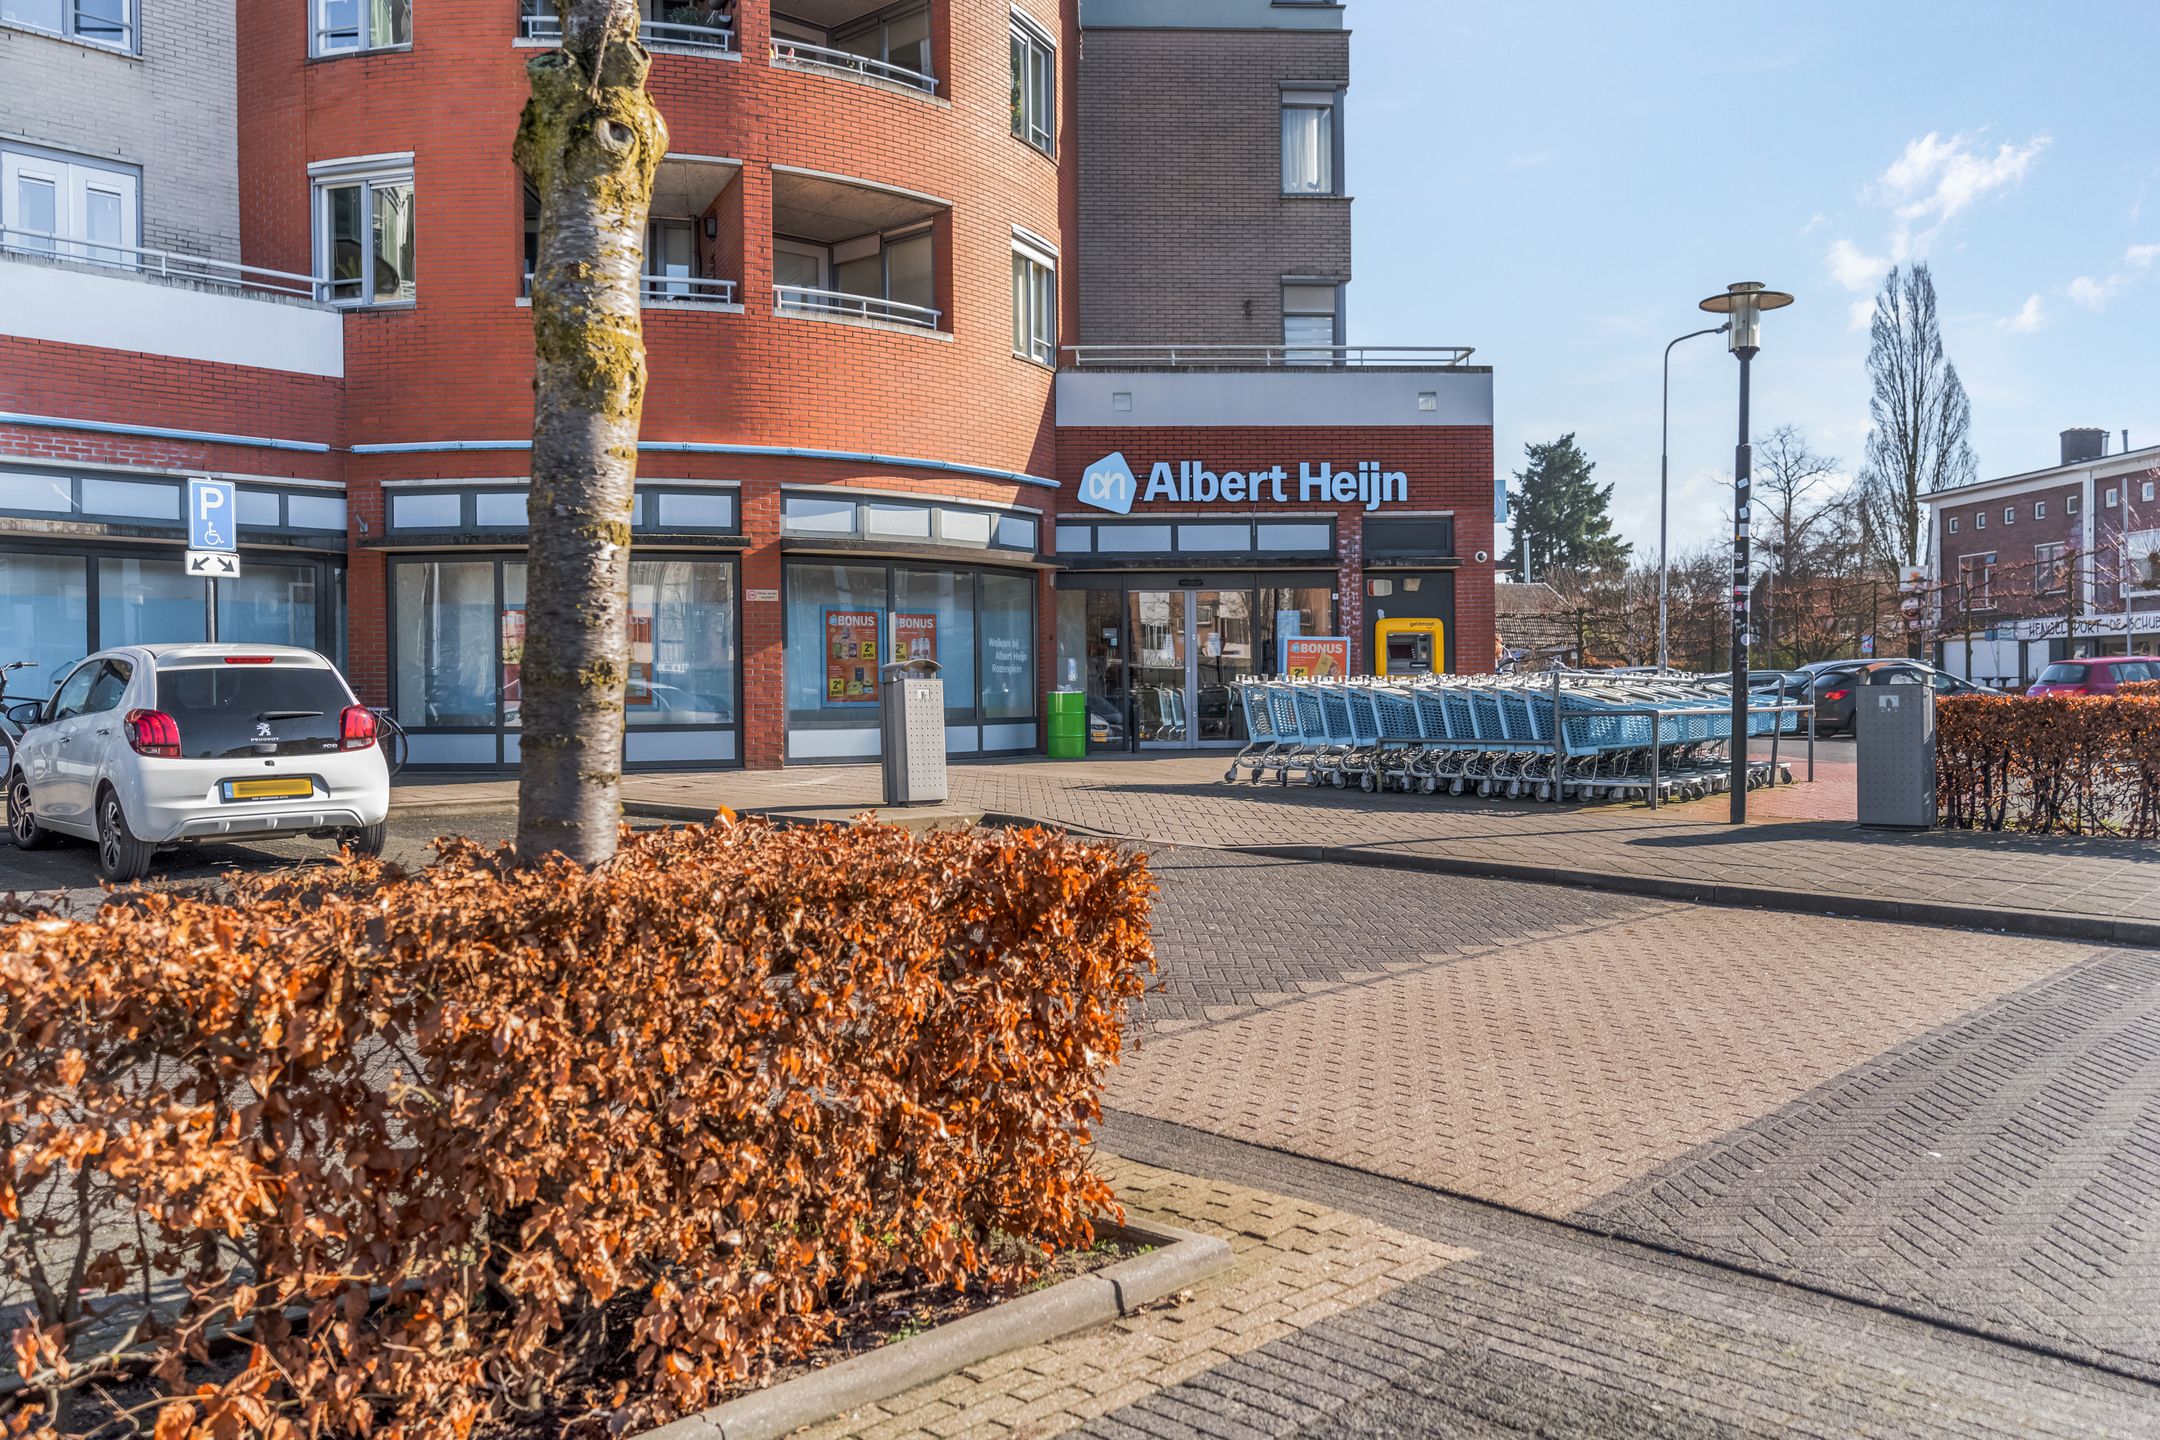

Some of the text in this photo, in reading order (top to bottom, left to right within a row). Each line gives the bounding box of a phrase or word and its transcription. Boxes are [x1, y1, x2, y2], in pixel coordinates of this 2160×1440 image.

[1144, 461, 1288, 502] Albert
[1299, 461, 1408, 511] Heijn
[200, 486, 224, 520] P
[837, 615, 875, 627] BONUS
[899, 618, 934, 629] BONUS
[2029, 618, 2101, 637] HENGELPORT
[988, 638, 1011, 648] Welkom
[1300, 643, 1343, 654] BONUS
[995, 651, 1012, 661] Albert
